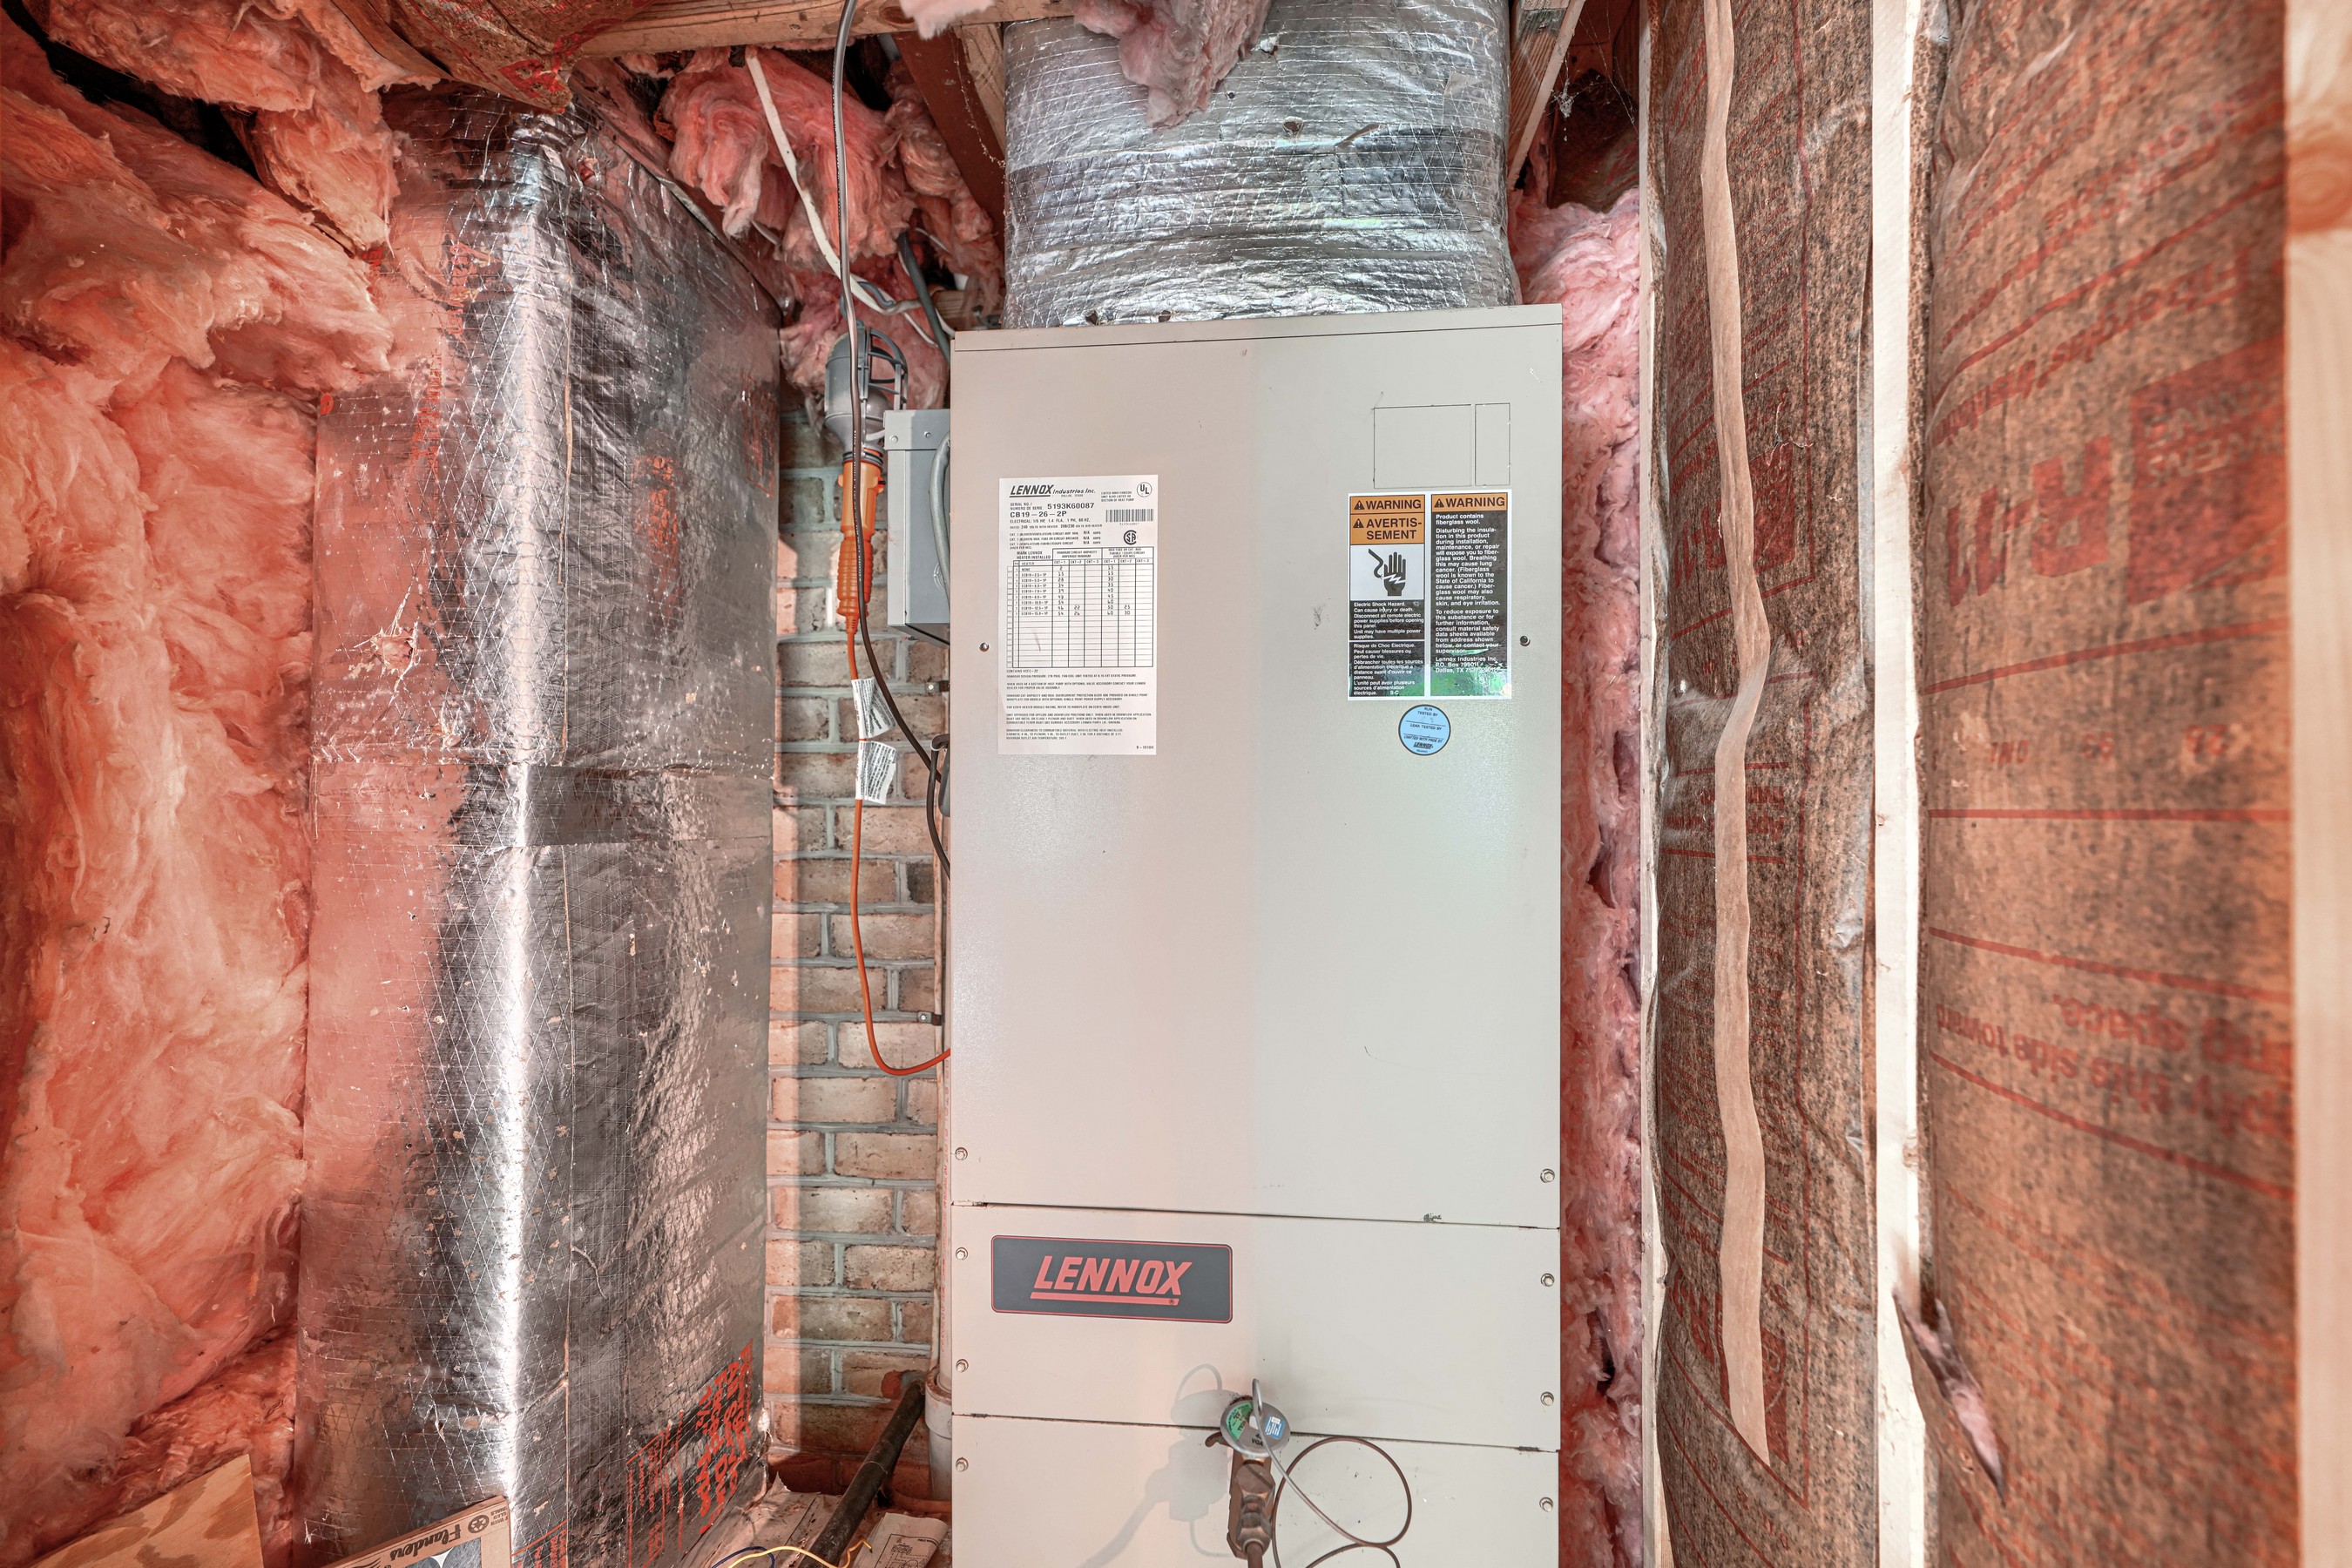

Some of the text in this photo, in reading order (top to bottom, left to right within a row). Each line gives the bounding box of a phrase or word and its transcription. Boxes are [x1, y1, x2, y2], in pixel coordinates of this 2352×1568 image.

[1010, 484, 1054, 495] LENNOX
[1140, 484, 1149, 494] UL
[1366, 499, 1422, 510] WARNING
[1445, 497, 1505, 507] WARNING
[1366, 517, 1423, 528] AVERTIS-
[1947, 435, 2112, 607] R-11
[1366, 531, 1416, 540] SEMENT
[1935, 1003, 2009, 1057] toward
[2052, 993, 2188, 1052] space.
[2012, 1033, 2079, 1084] side
[1033, 1255, 1193, 1296] LENNOX
[390, 1524, 462, 1561] Flanders
